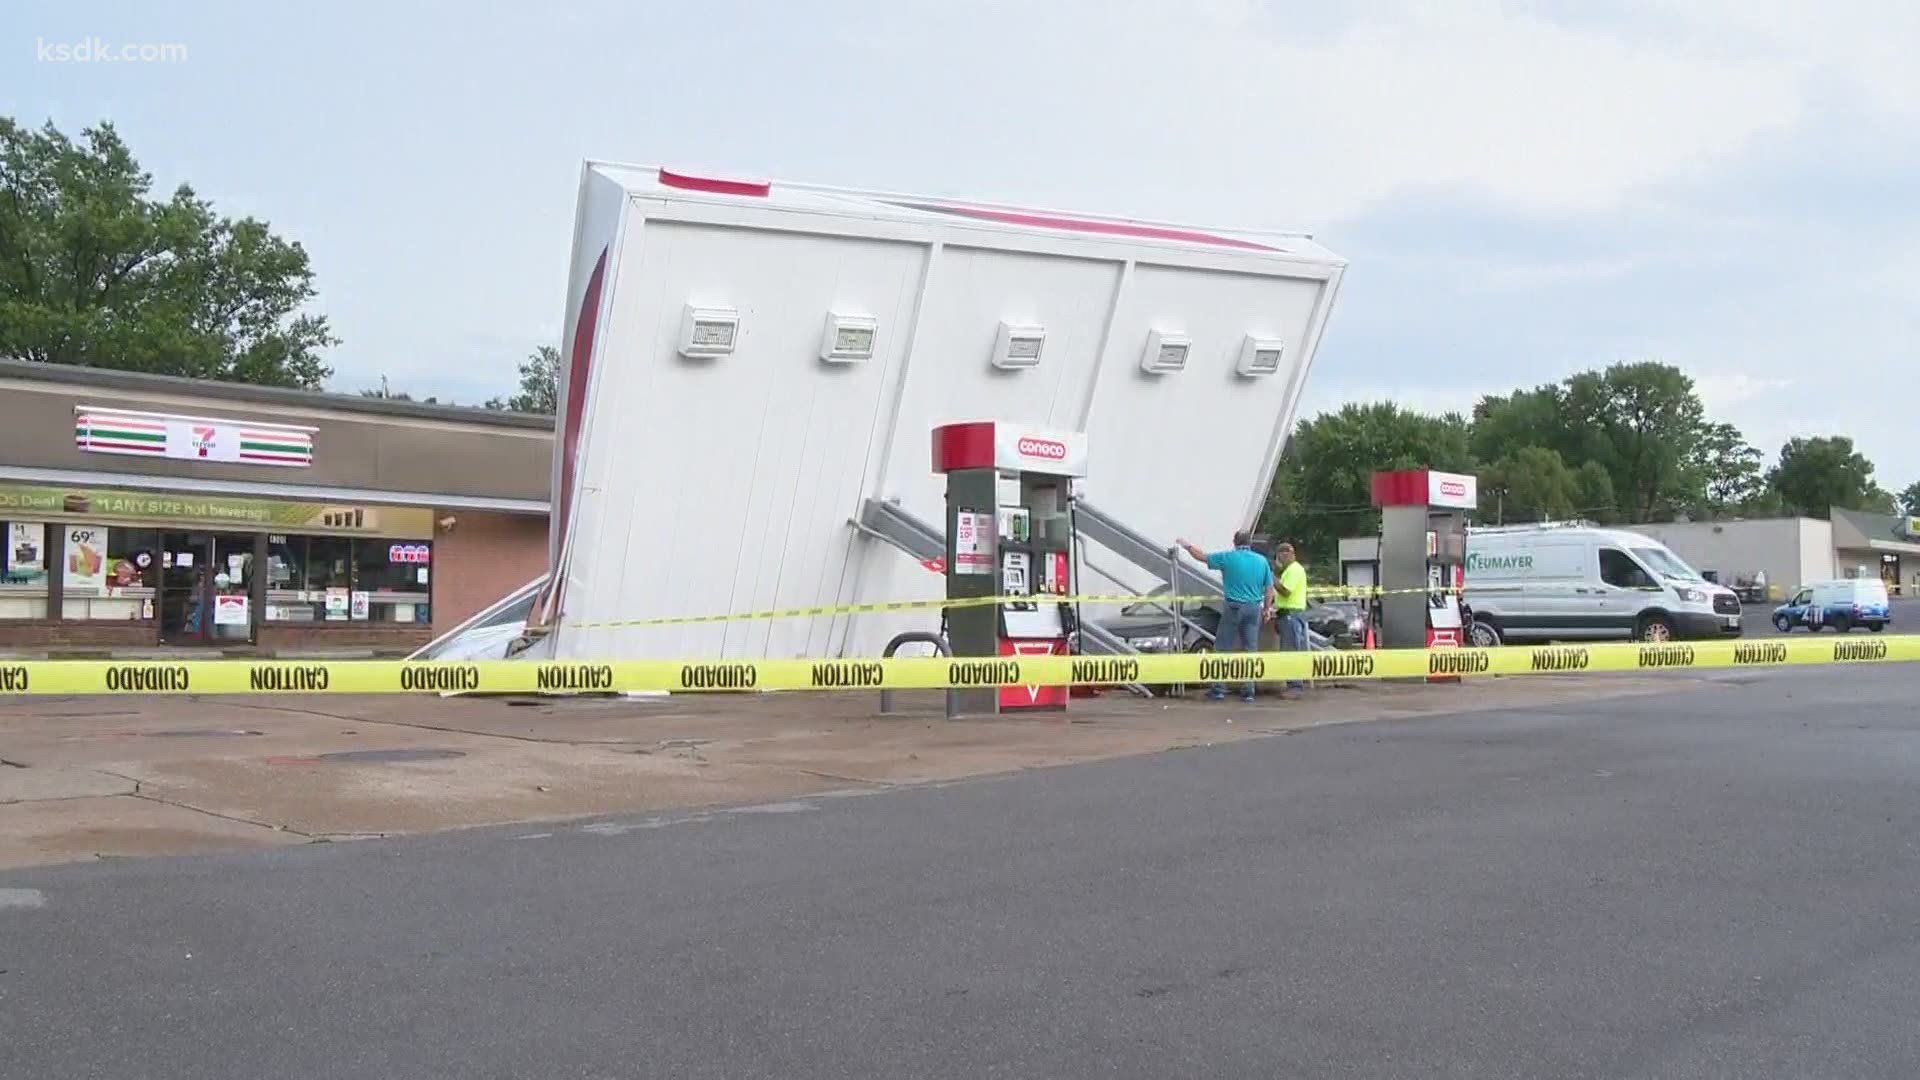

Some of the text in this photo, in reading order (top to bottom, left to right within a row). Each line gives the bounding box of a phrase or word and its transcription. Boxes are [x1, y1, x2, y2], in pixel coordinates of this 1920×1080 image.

[1019, 440, 1064, 457] conoco
[21, 495, 55, 508] Deal
[112, 499, 147, 513] ANY
[147, 502, 181, 515] SIZE
[184, 504, 206, 516] hot
[0, 640, 1886, 690] CA CUIDADO CAUTION CUIDADO CAUTION CUIDADO CAUTION CUIDADO CAUTION CUIDADO CAUTION CUIDADO CAUTION CUIDADO CAUTION CUIDADO
